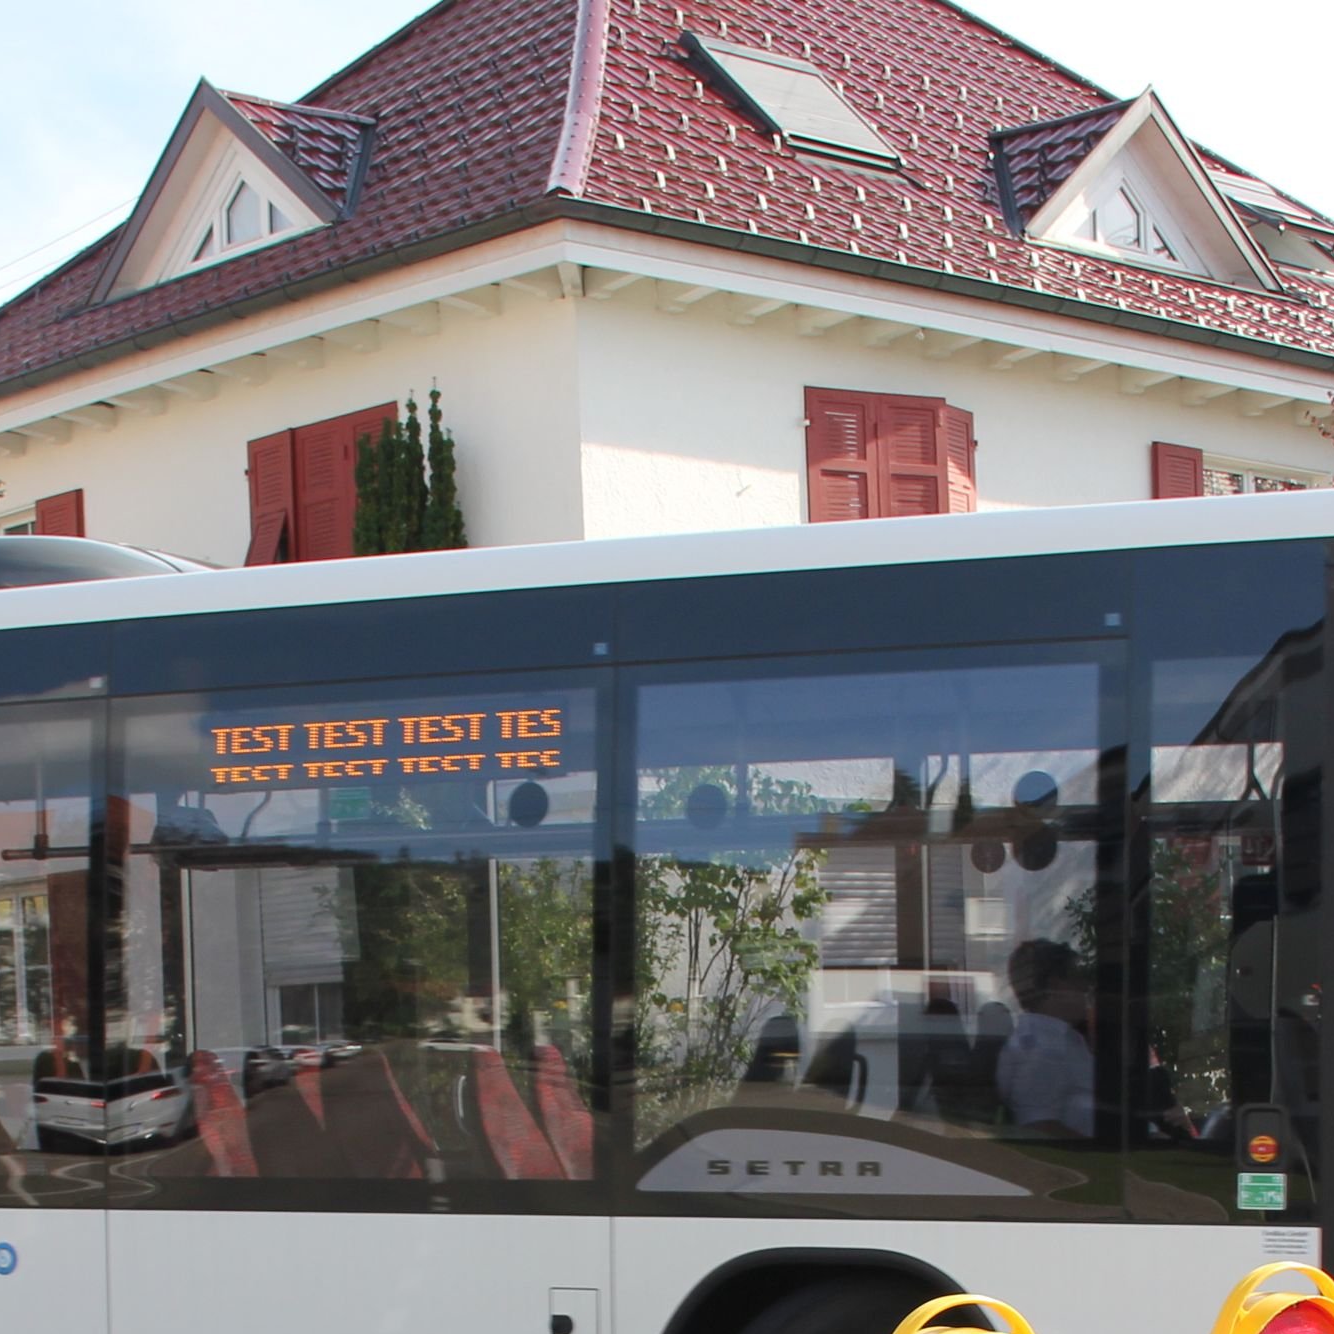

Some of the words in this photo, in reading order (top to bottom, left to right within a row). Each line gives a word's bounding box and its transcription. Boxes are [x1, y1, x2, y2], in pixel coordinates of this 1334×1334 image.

[211, 724, 295, 755] TEST
[303, 718, 390, 750] TEST
[397, 712, 487, 745] TEST
[495, 708, 562, 740] TES
[707, 1159, 883, 1178] SETRA
